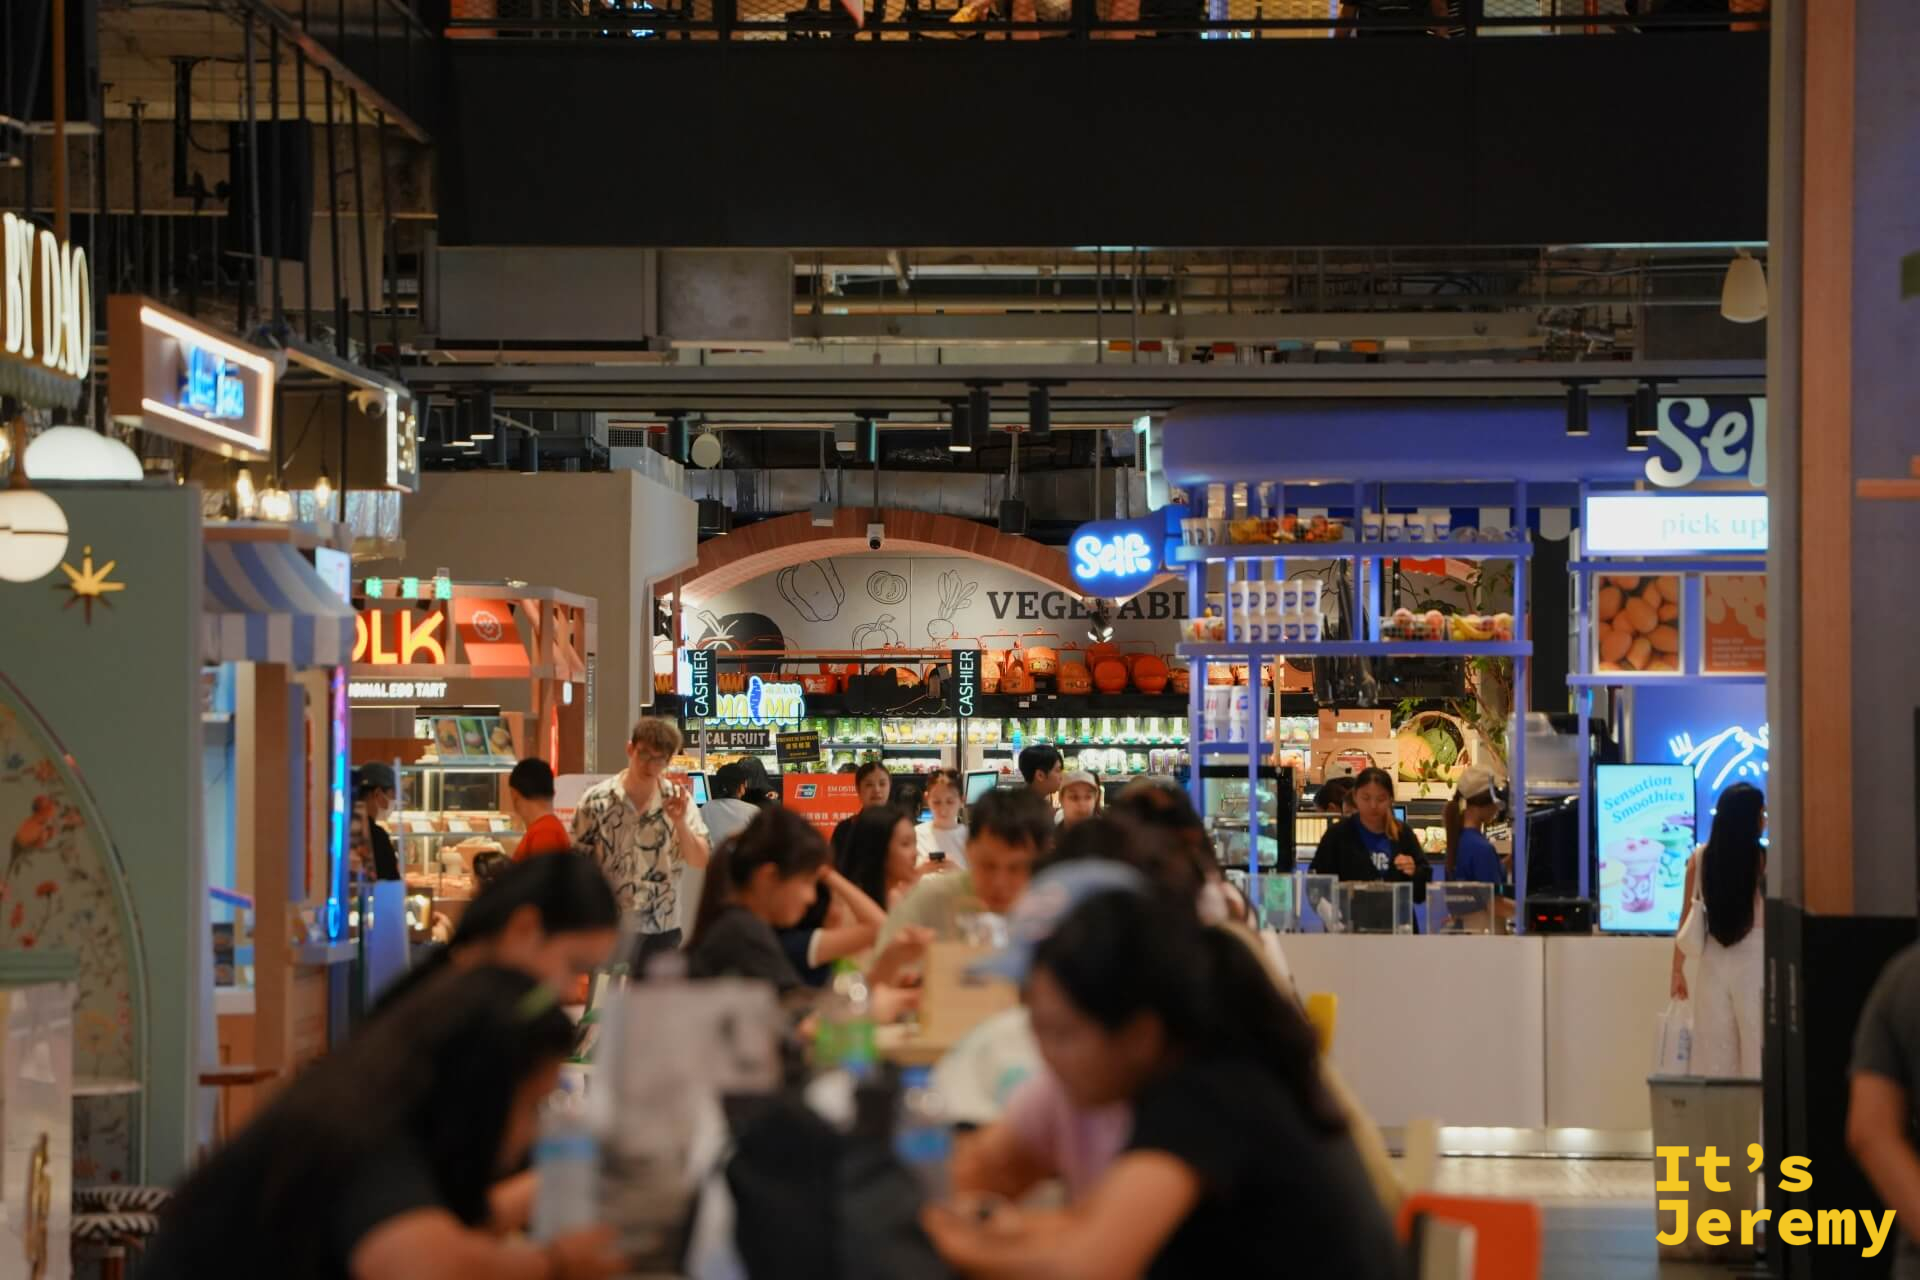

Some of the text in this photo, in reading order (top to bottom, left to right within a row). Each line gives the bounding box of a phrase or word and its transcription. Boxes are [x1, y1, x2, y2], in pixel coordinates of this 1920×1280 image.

[3, 211, 35, 359] BY
[1661, 511, 1767, 541] pick up
[986, 590, 1189, 620] VEGEABL
[415, 682, 447, 698] TART
[694, 650, 709, 717] CASHIER
[959, 650, 974, 717] CASHIER
[730, 732, 766, 745] FRUIT
[1603, 775, 1672, 810] Sensation
[1612, 788, 1686, 823] Smoothies
